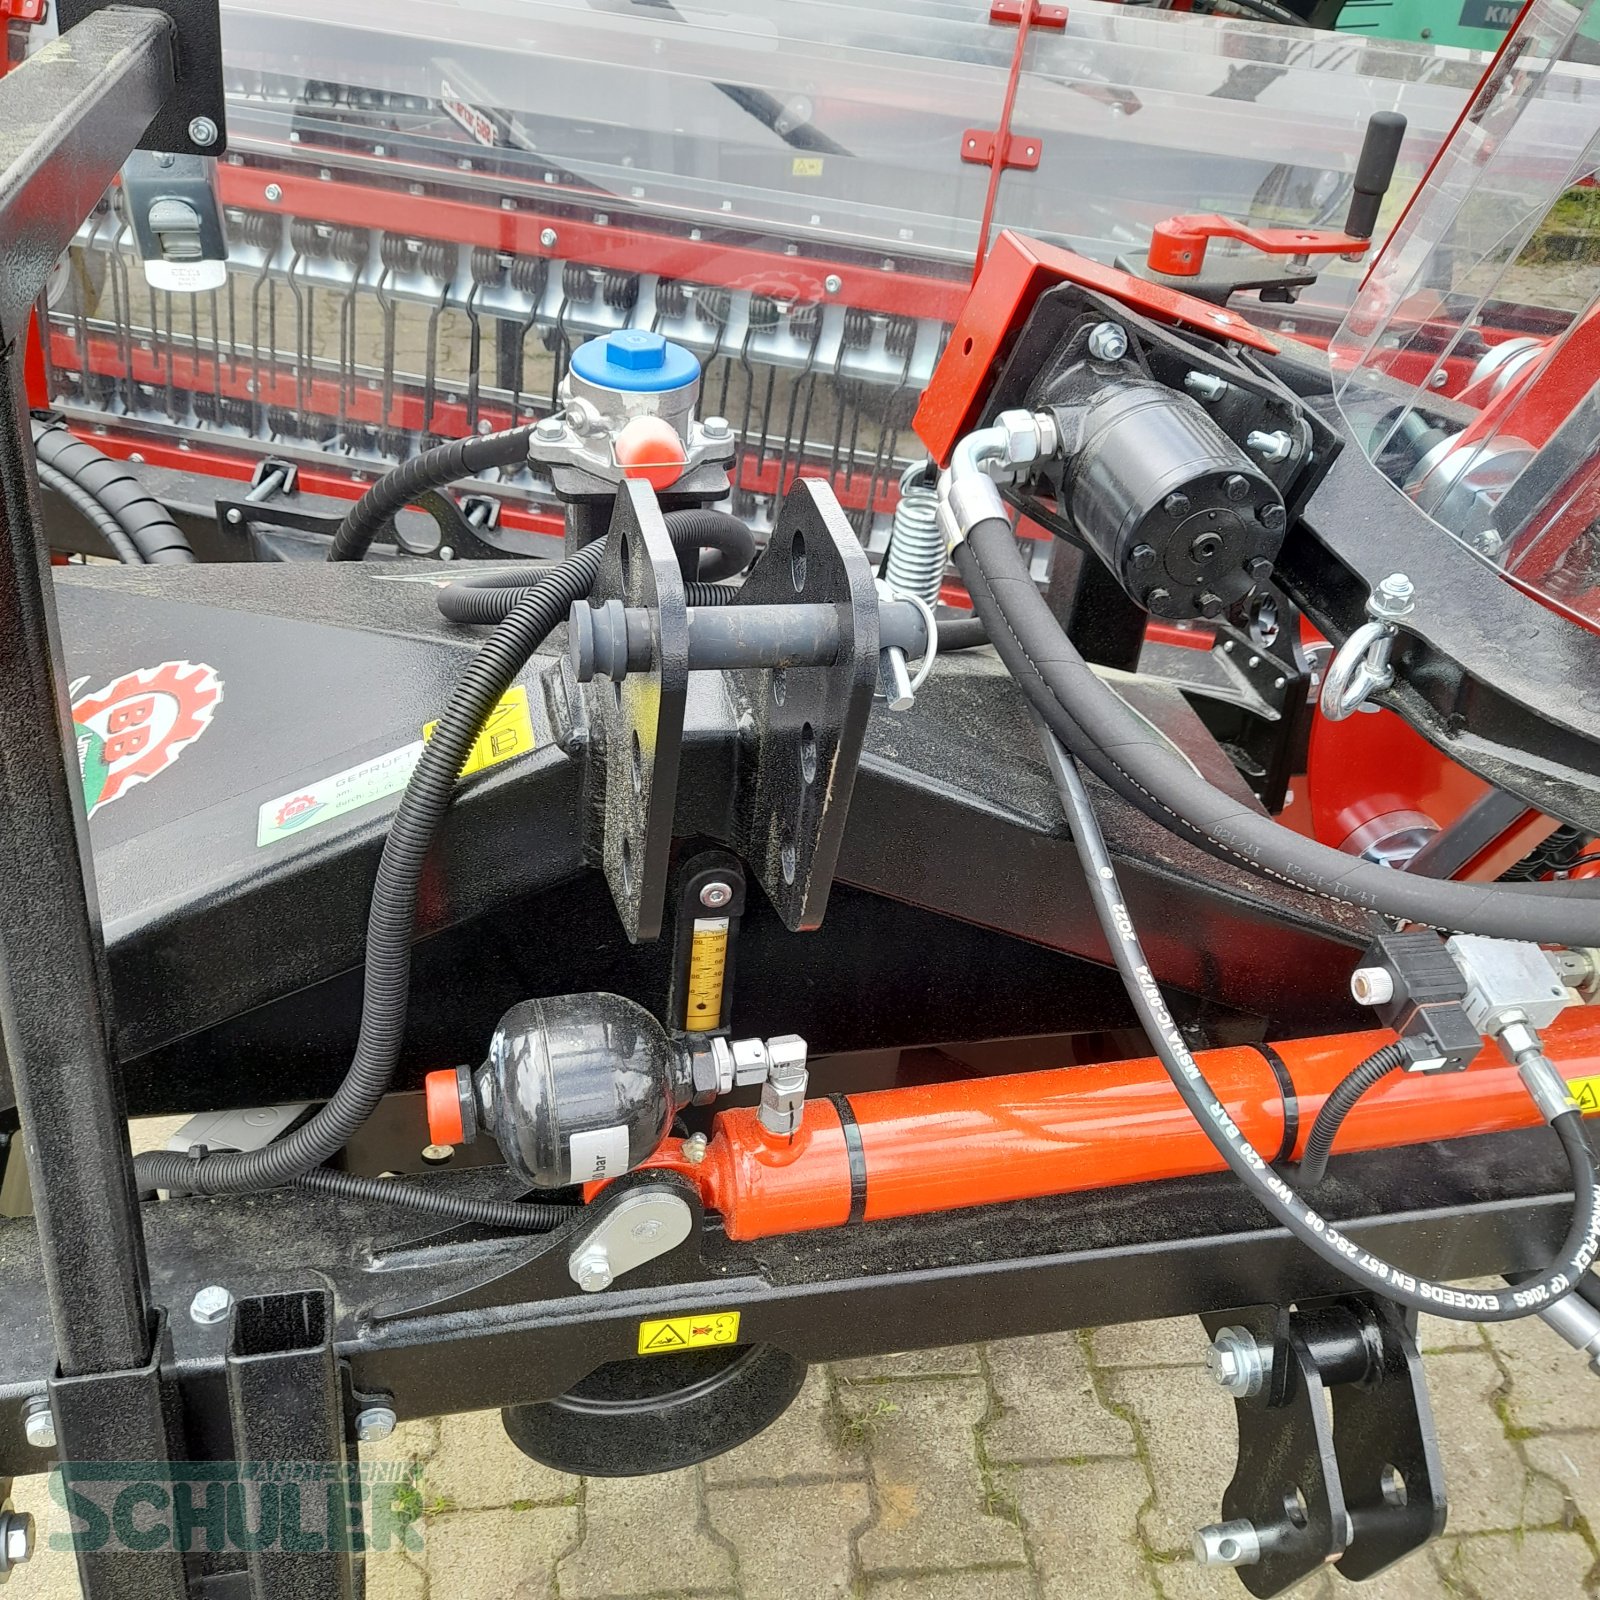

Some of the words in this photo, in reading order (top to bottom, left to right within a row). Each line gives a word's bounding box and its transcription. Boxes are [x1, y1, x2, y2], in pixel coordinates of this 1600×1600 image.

[107, 696, 155, 765] BB
[335, 751, 412, 788] GEPRÜFT
[1136, 965, 1174, 1030] IC-08/24
[1168, 1030, 1202, 1080] MSHA
[1209, 1101, 1240, 1140] BAR
[592, 1155, 606, 1172] bar
[1240, 1142, 1266, 1170] 420
[1267, 1177, 1293, 1205] WP
[1304, 1211, 1325, 1232] 08
[1325, 1229, 1359, 1258] 2SC
[1358, 1254, 1389, 1278] 857
[1391, 1269, 1416, 1293] EN
[1551, 1273, 1570, 1294] KP
[1420, 1282, 1500, 1310] EXCEEDS
[1512, 1284, 1550, 1308] 208S
